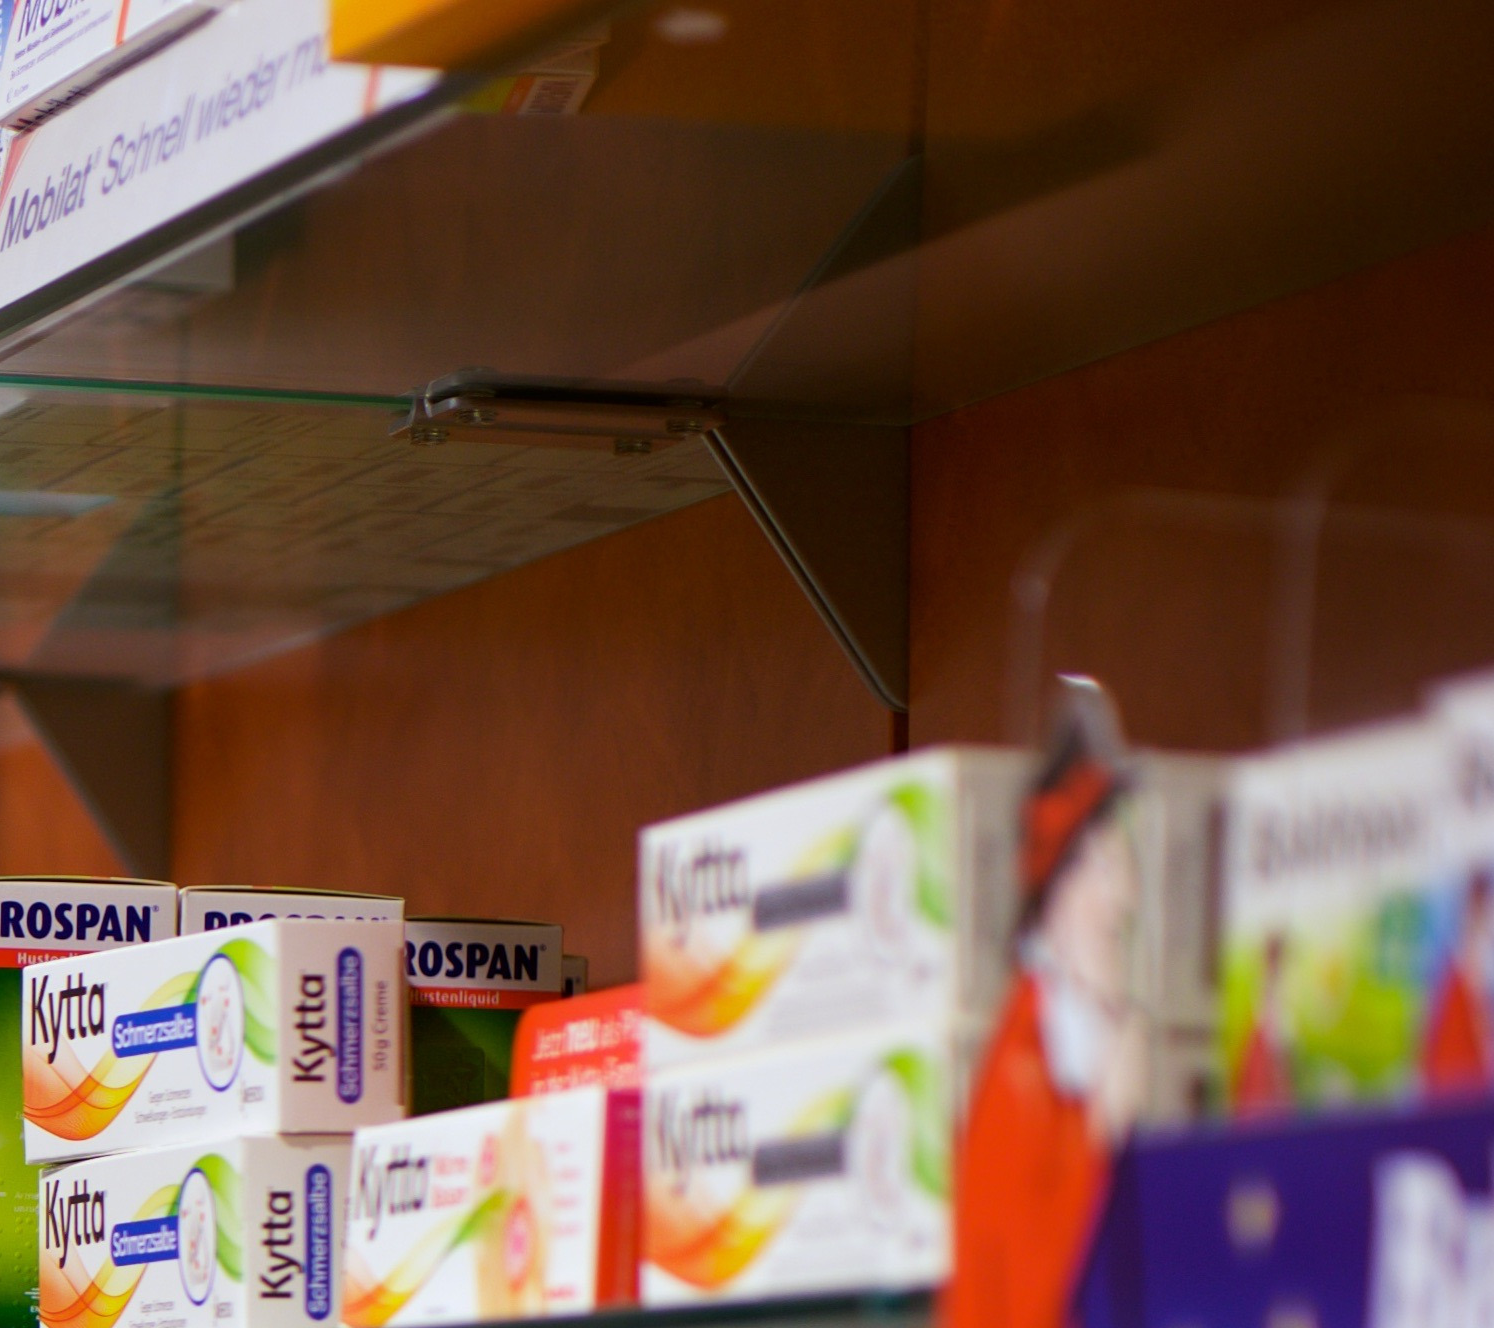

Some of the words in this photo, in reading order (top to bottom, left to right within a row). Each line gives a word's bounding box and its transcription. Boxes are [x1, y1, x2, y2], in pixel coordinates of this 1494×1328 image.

[30, 972, 107, 1063] Kytta
[113, 1012, 195, 1051] Schmerzsalbe
[292, 972, 337, 1083] Kytta
[339, 953, 361, 1098] Schmerzsalbe
[45, 1178, 106, 1269] Kytta
[352, 1142, 430, 1240] Kytta
[112, 1222, 177, 1260] Schmerzsalbe
[261, 1189, 306, 1300] Kytta
[308, 1172, 329, 1316] Schmerzsalbe
